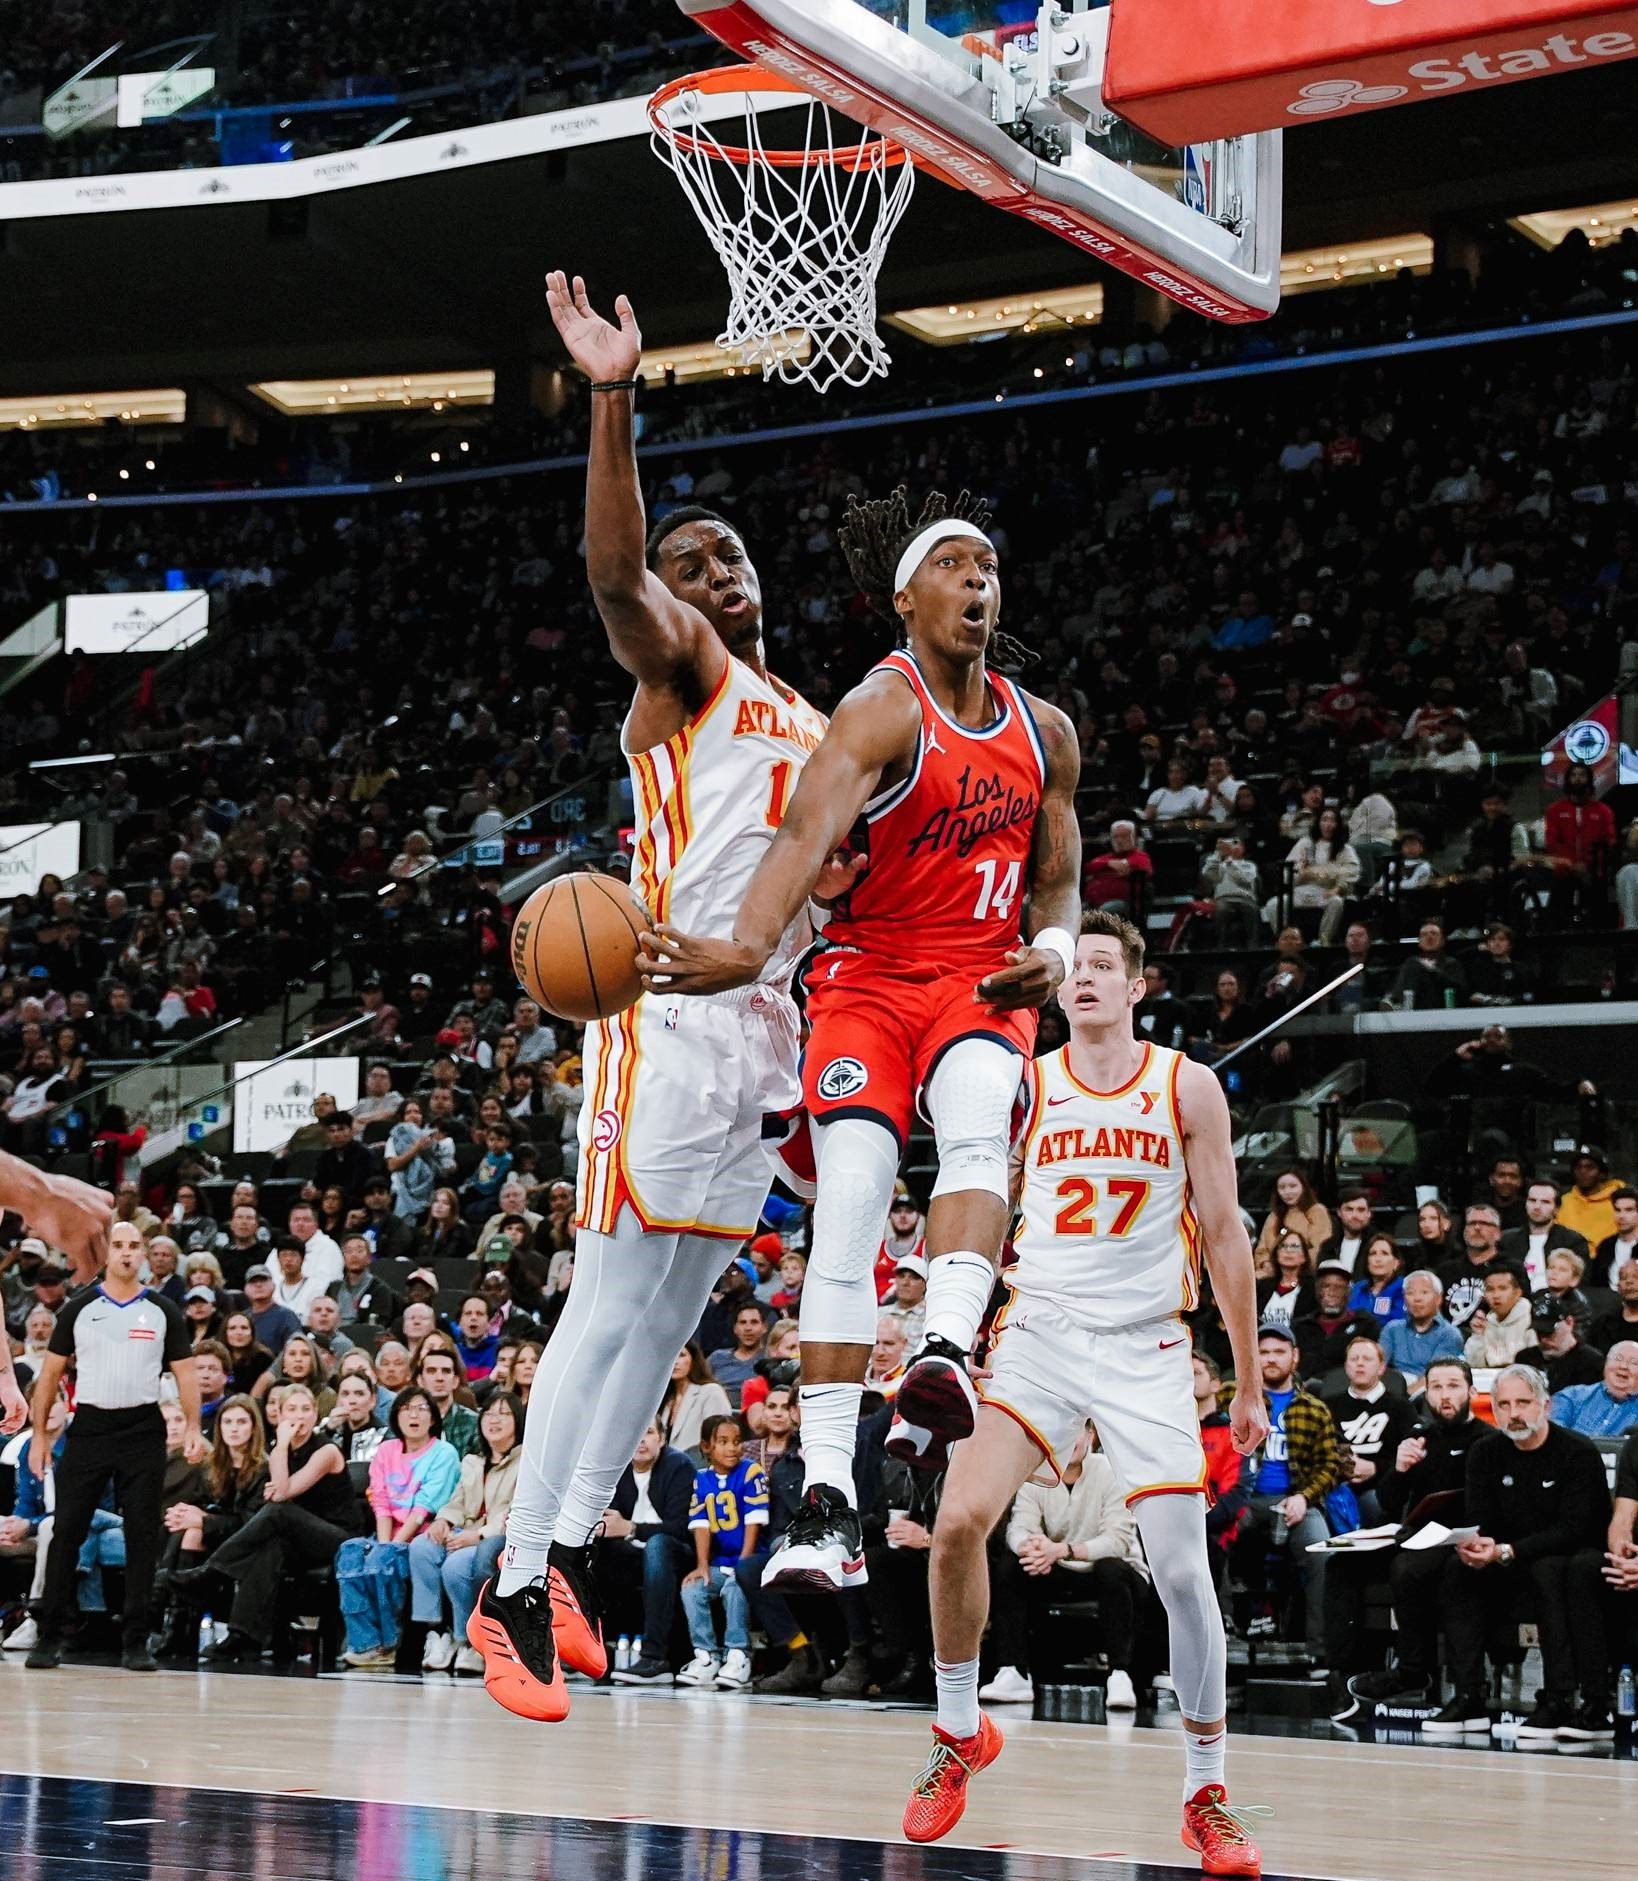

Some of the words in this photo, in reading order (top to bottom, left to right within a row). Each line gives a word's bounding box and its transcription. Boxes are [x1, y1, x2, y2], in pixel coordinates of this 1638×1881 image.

[742, 39, 803, 75] HERDEZ
[799, 70, 855, 104] SALSA
[1407, 31, 1637, 91] State
[889, 125, 950, 162] HERDEZ
[941, 154, 993, 188] SALSA
[1022, 207, 1074, 232] HERDEZ
[1068, 229, 1117, 255] SALSA
[1142, 271, 1195, 298] HERDEZ
[1186, 294, 1232, 318] SALSA
[955, 765, 1005, 812] Los
[907, 785, 1036, 859] Angeles
[973, 859, 1022, 921] 14
[1036, 1127, 1170, 1170] ATLANTA
[1055, 1175, 1151, 1237] 27
[705, 1490, 739, 1534] 13
[1388, 1707, 1413, 1718] KAISER
